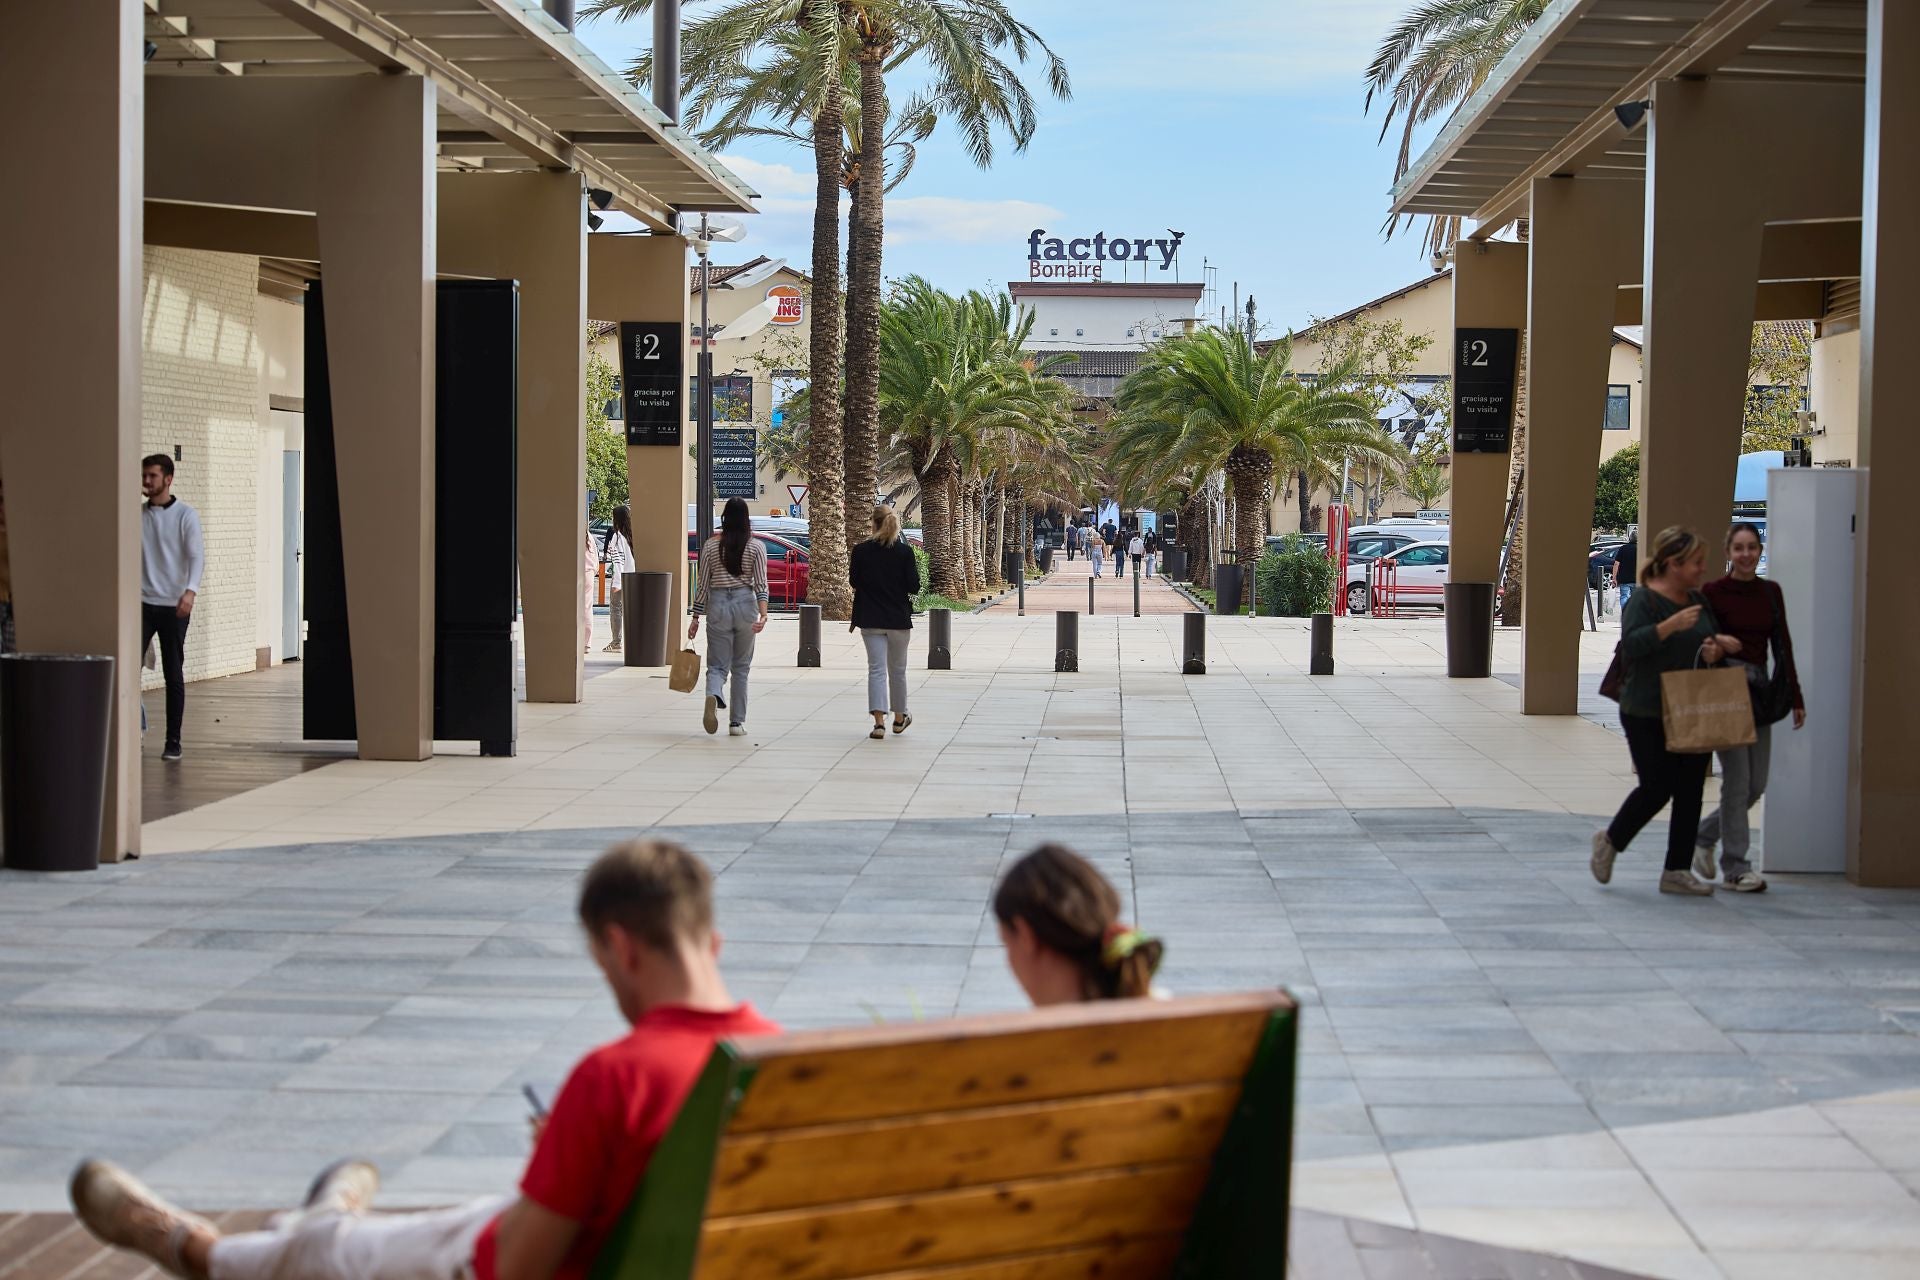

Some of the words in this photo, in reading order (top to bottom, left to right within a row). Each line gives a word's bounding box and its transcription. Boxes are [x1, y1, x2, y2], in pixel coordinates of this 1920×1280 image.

[1027, 228, 1182, 270] factory
[1029, 259, 1102, 278] Bonaire
[777, 305, 801, 316] ING
[643, 333, 660, 360] 2
[1471, 340, 1488, 366] 2
[634, 388, 660, 398] gracias
[662, 389, 675, 398] por
[639, 399, 648, 407] tu
[649, 399, 670, 407] visita
[1461, 395, 1488, 404] gracias
[1490, 396, 1504, 404] por
[1477, 405, 1498, 413] visita
